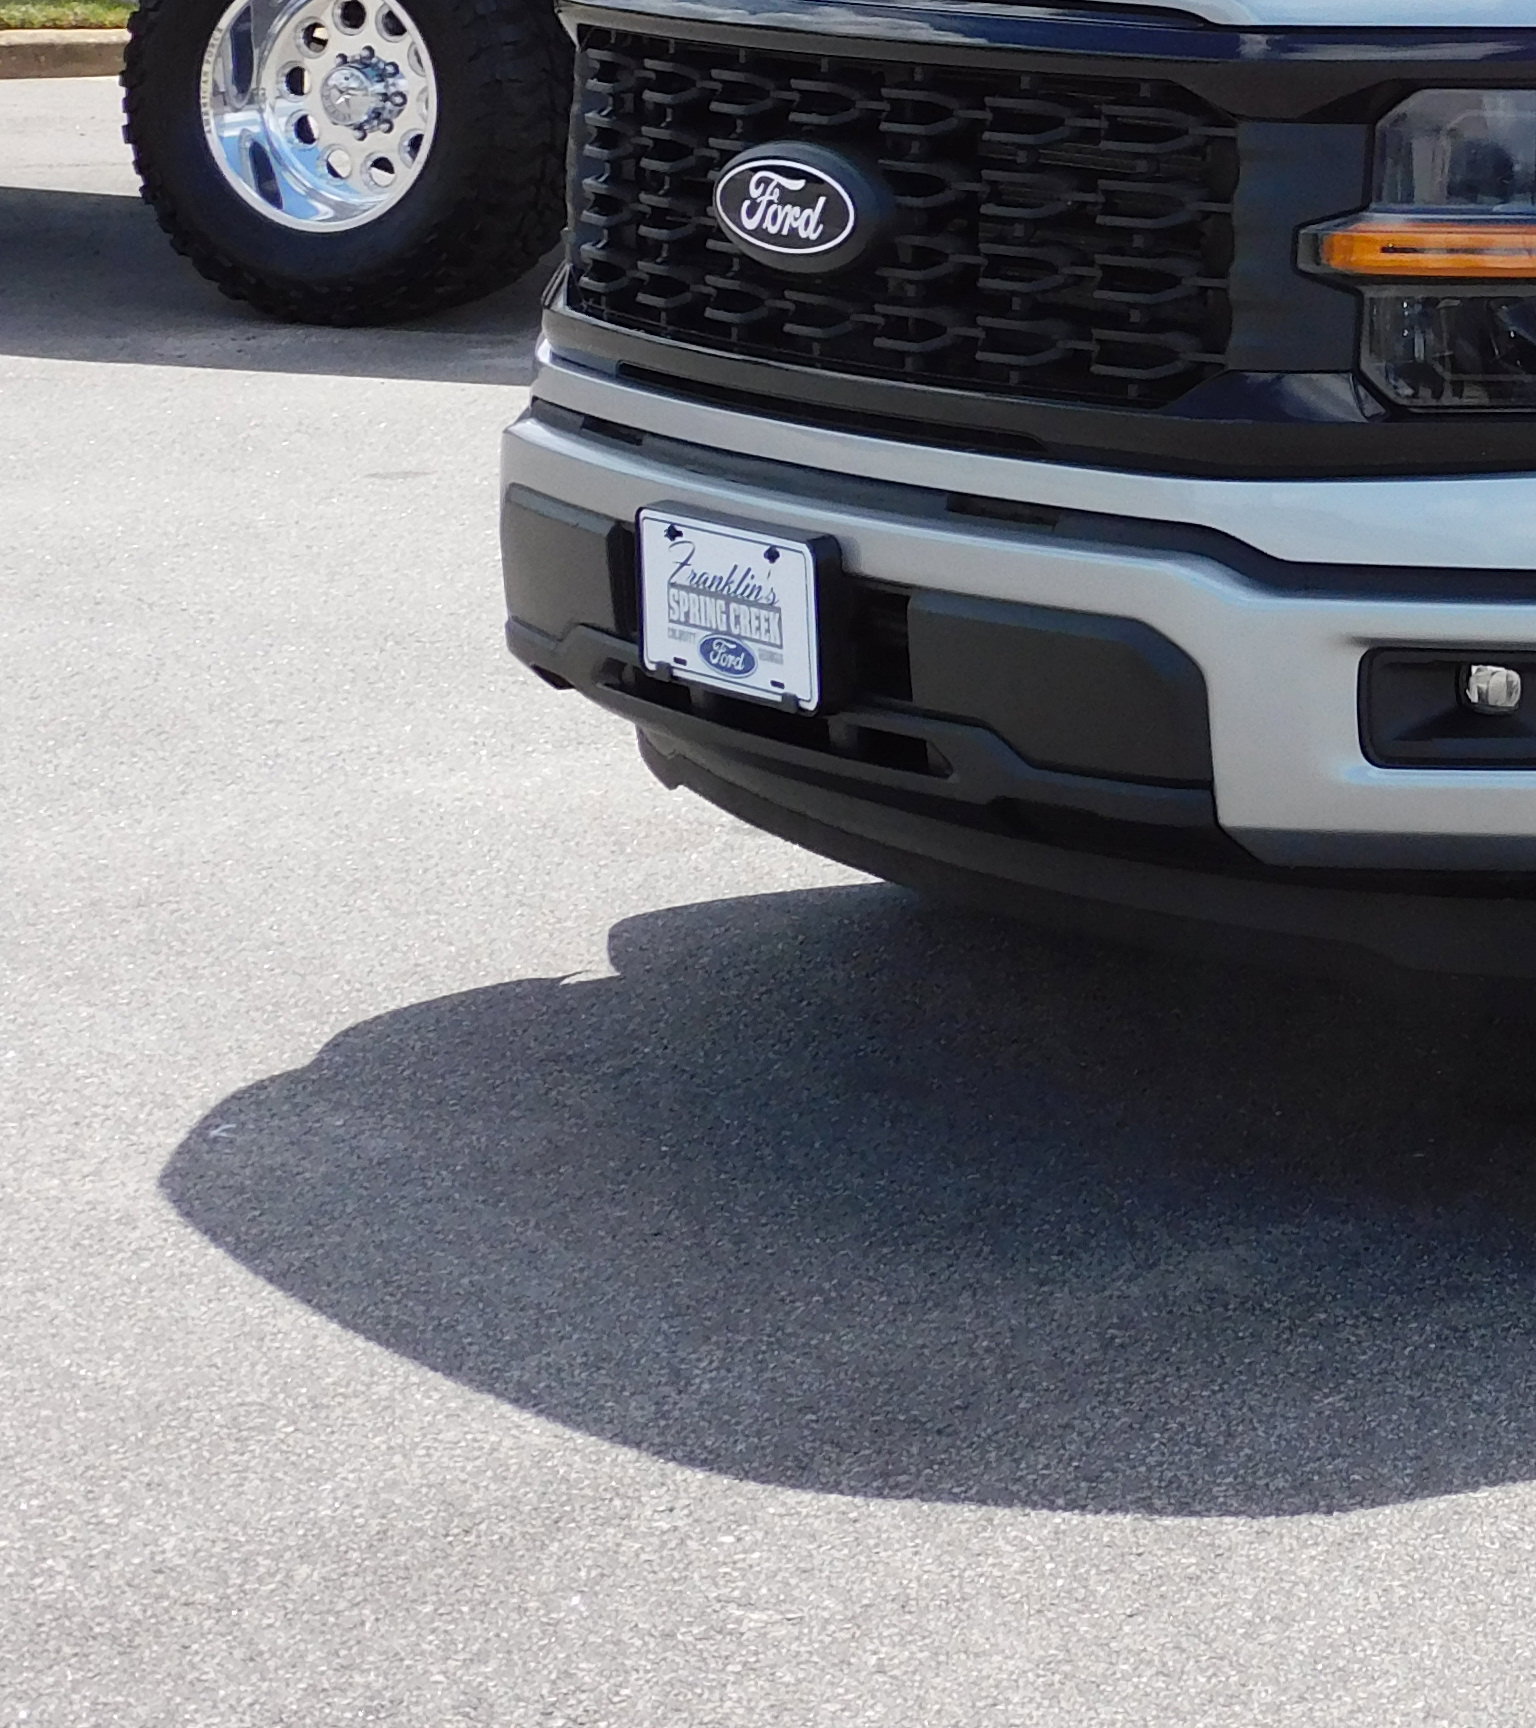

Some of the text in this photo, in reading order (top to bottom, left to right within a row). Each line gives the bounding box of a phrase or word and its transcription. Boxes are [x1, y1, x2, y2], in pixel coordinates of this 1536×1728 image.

[741, 170, 827, 241] Ford
[668, 540, 780, 607] Franklin's
[669, 587, 728, 632] SPRING
[729, 601, 780, 646] CREEK
[709, 638, 745, 671] Ford
